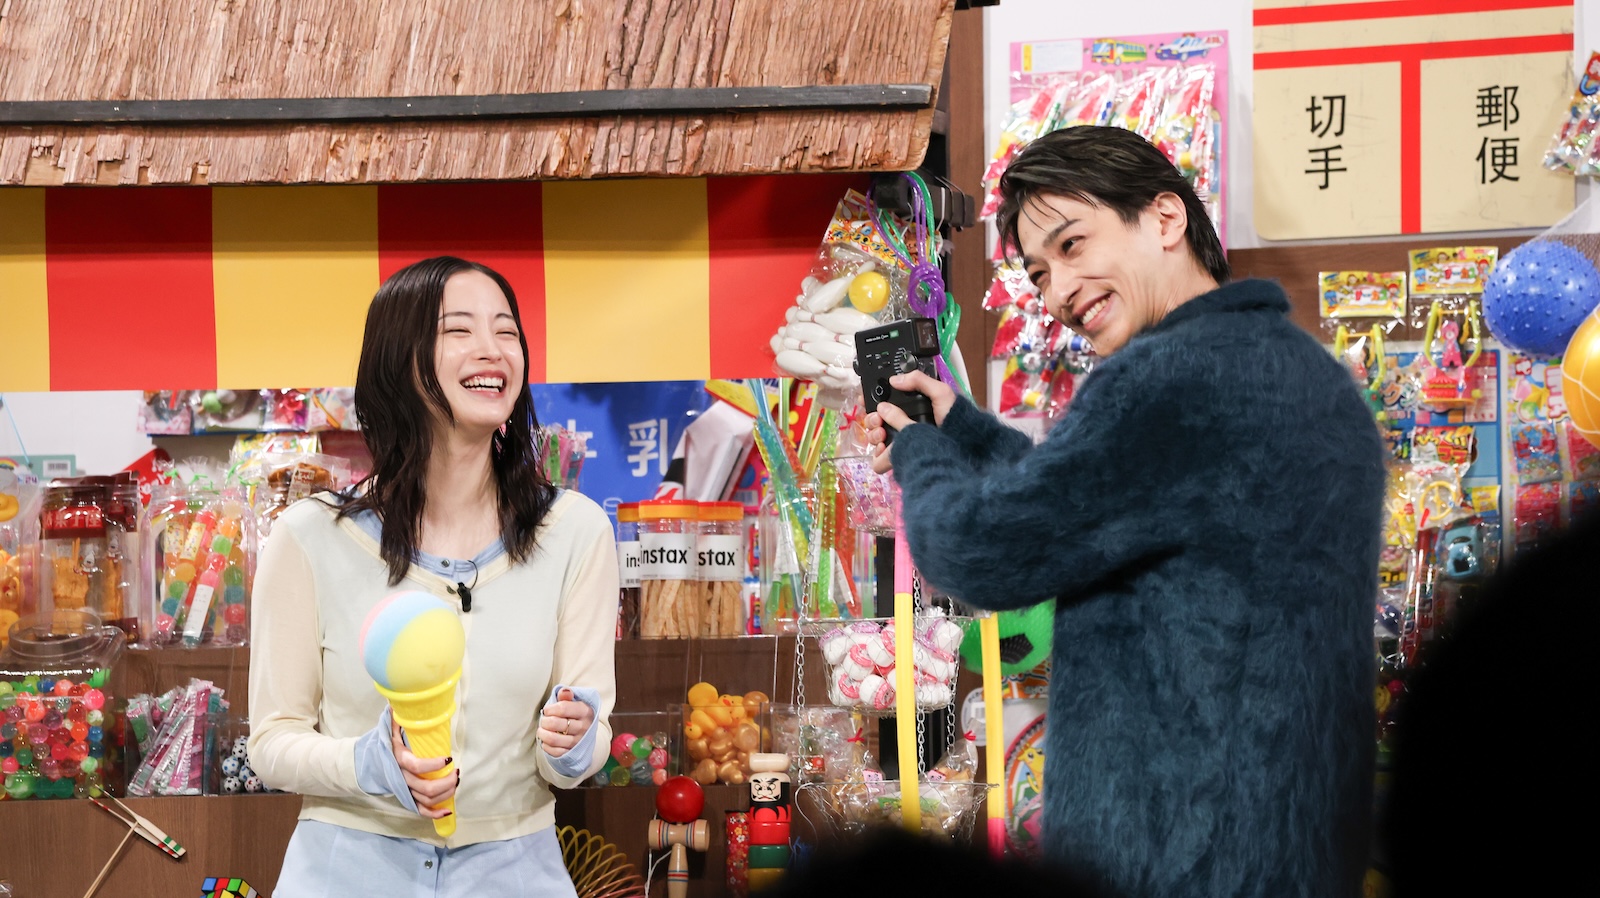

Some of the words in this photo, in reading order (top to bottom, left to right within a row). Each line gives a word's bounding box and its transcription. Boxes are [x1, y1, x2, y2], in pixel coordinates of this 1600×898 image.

[1305, 94, 1347, 190] 切手
[1475, 84, 1520, 185] 郵便
[640, 546, 688, 565] instax
